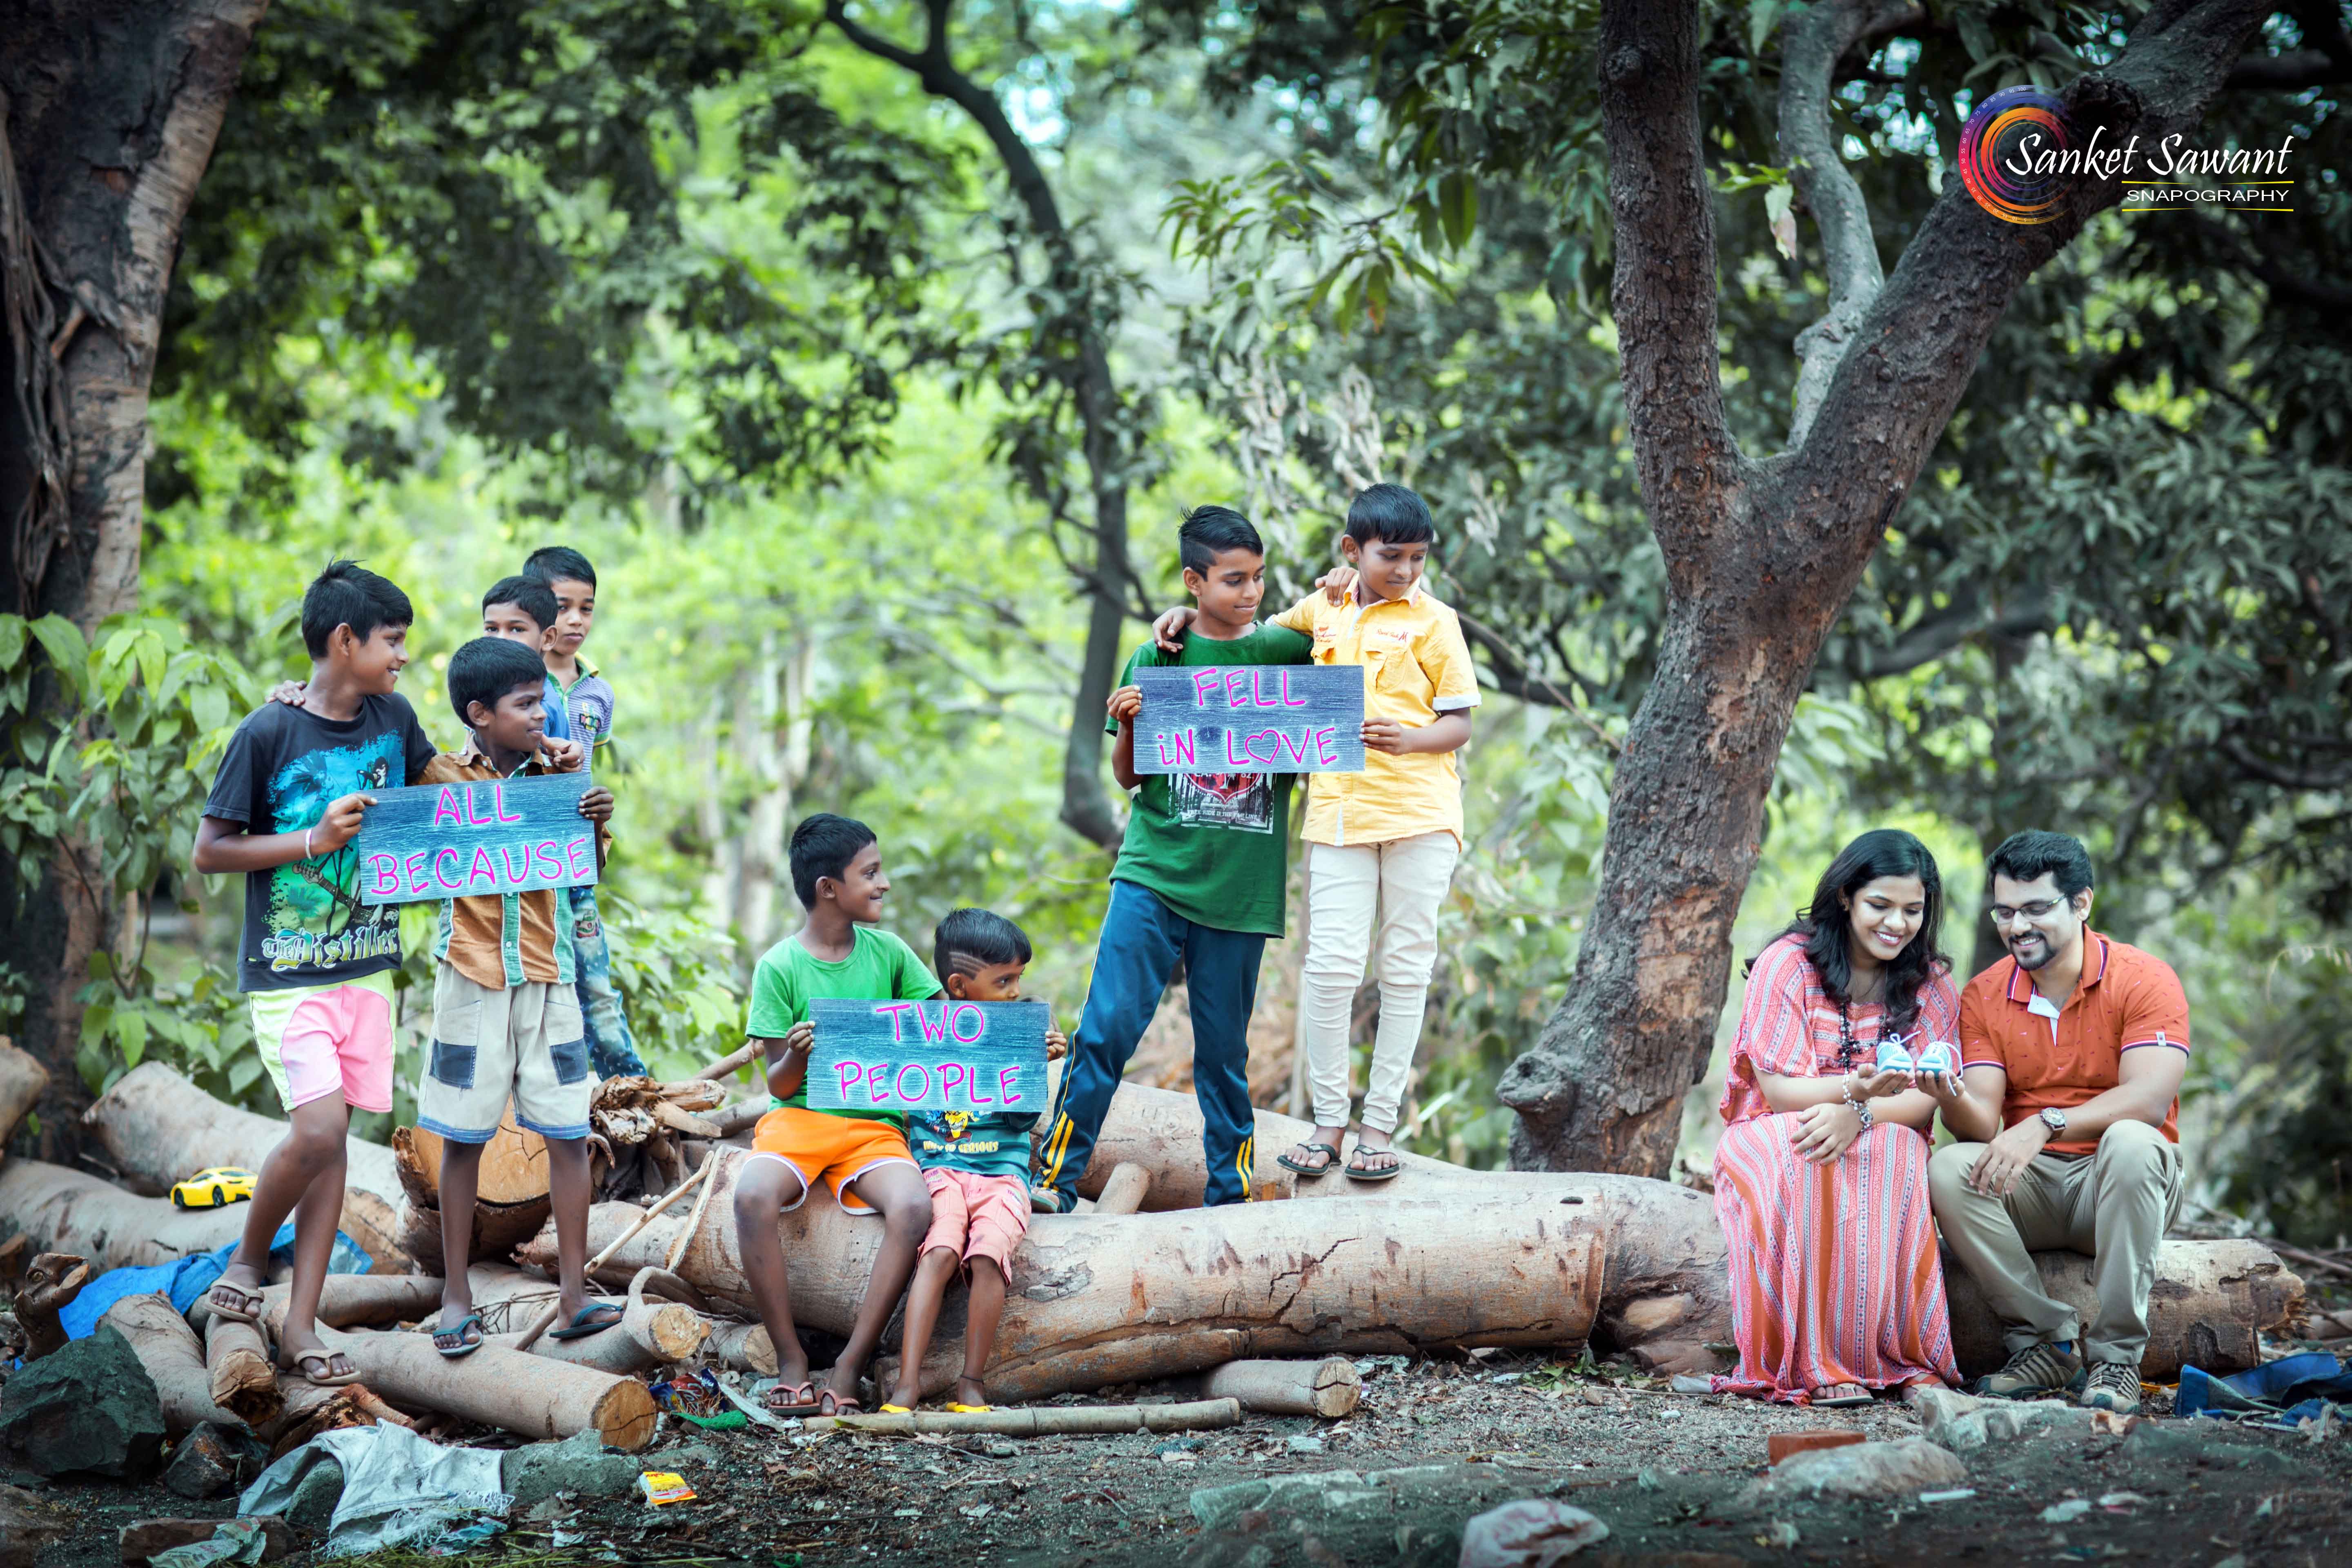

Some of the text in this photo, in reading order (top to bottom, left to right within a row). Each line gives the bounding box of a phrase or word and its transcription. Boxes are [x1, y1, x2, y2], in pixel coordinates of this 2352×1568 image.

[1193, 668, 1305, 707] FELL
[436, 786, 520, 825] ALL
[369, 839, 589, 895] BECAUSE
[876, 1004, 984, 1043] TWO
[835, 1062, 1022, 1105] PEOPLE
